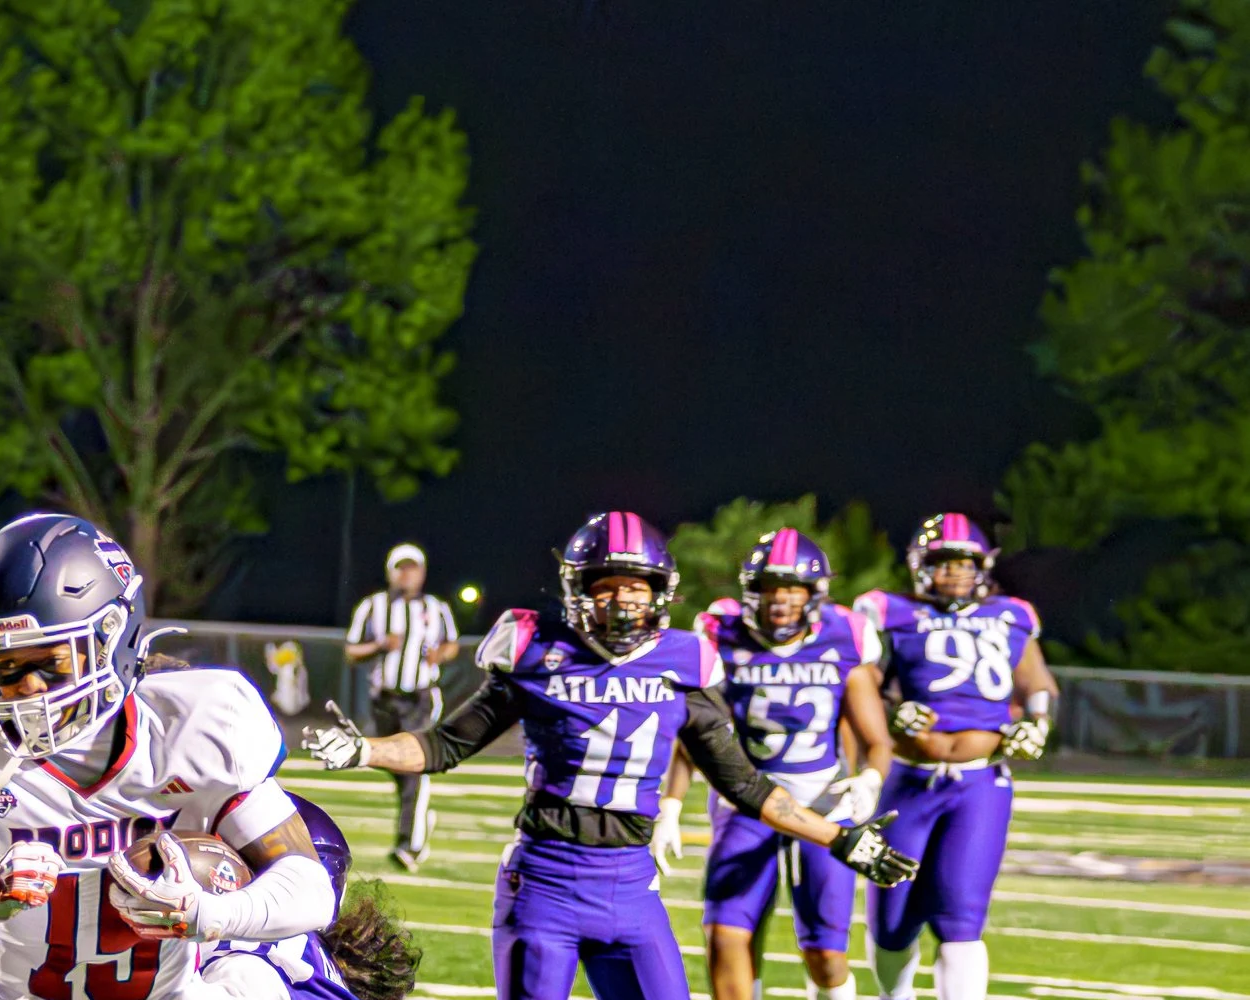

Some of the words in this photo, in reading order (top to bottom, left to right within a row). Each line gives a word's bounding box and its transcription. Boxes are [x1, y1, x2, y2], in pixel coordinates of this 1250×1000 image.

[544, 675, 676, 703] ATLANTA
[732, 662, 841, 685] ATLANTA
[924, 628, 1014, 701] 98
[567, 708, 660, 811] 11
[747, 685, 833, 763] 52
